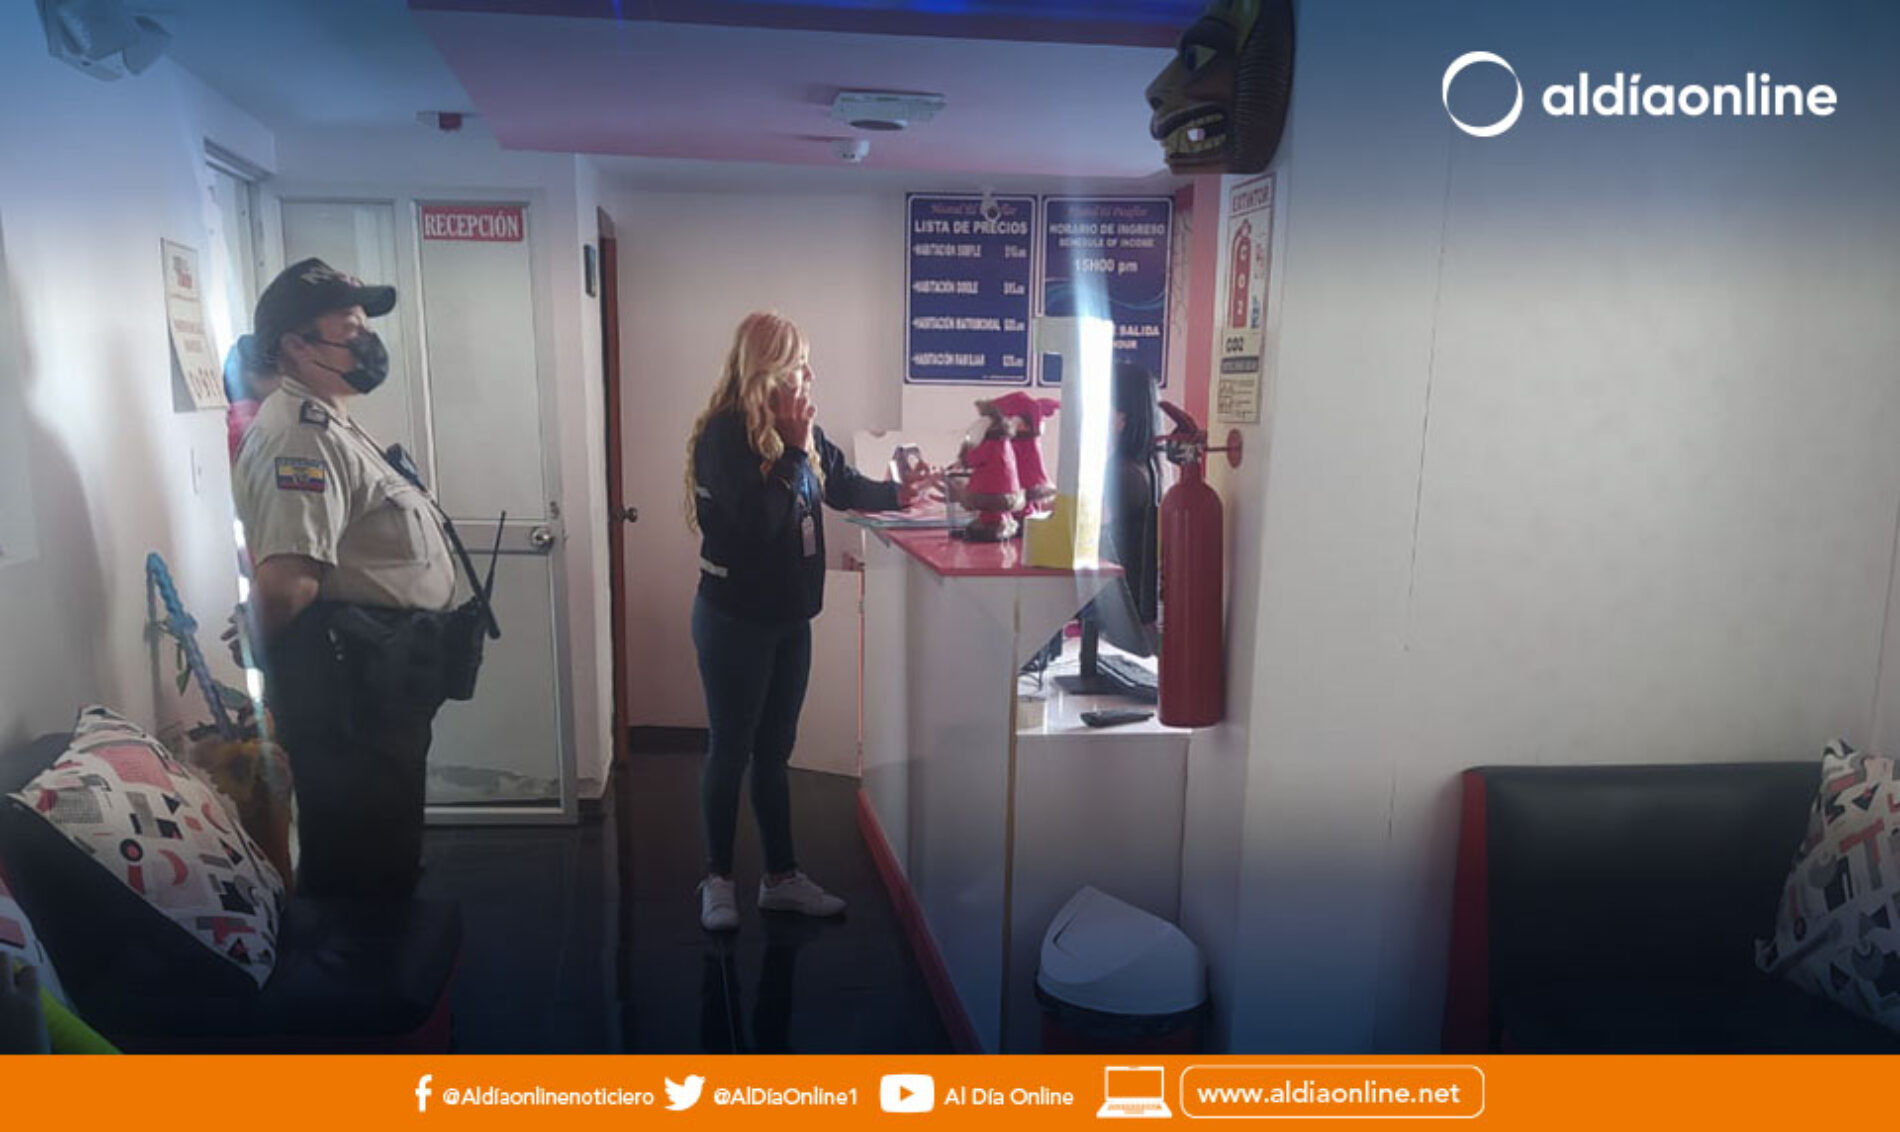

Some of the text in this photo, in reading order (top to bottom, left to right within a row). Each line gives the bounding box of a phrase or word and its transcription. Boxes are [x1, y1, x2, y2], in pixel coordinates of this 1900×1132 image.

[424, 208, 520, 238] RECEPCIÓN
[914, 220, 1028, 235] LISTA DE PRECIOS
[1049, 223, 1166, 236] HORARIO DE INGRESO
[1117, 261, 1139, 276] pm
[1118, 325, 1160, 336] SALIDA
